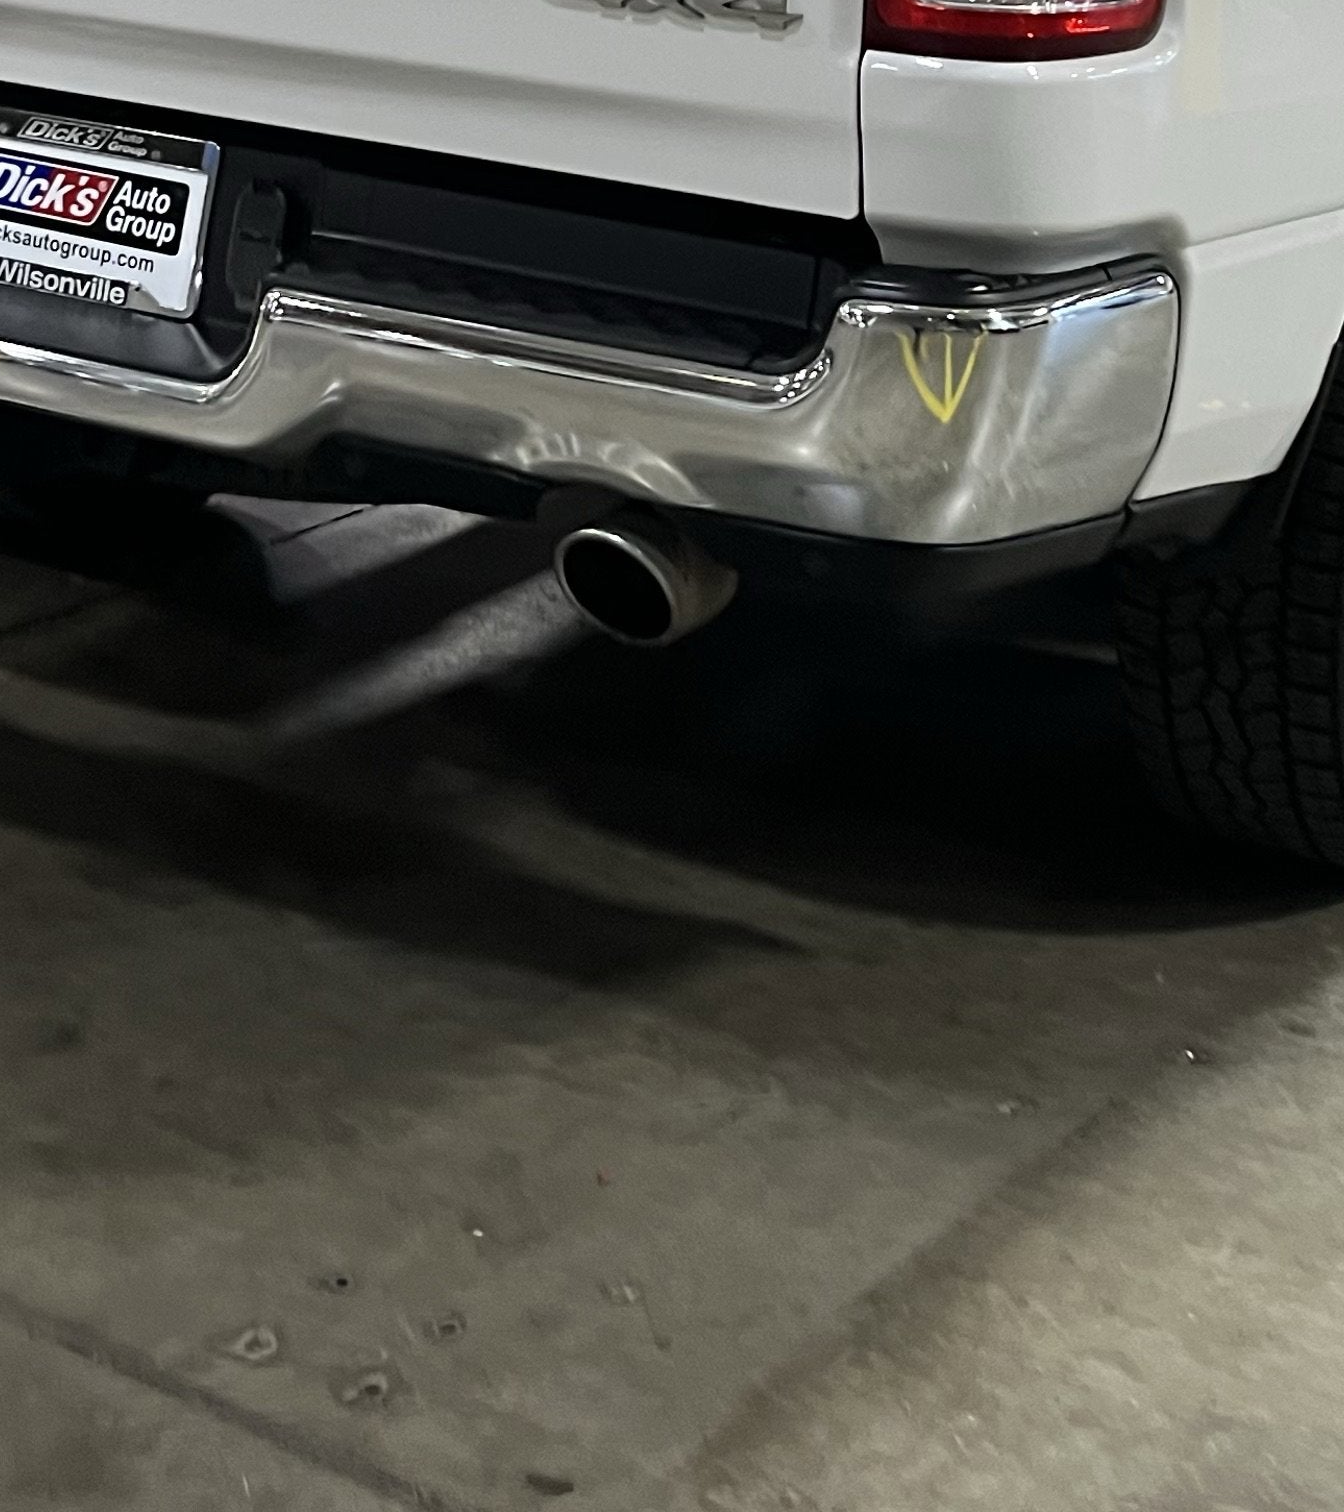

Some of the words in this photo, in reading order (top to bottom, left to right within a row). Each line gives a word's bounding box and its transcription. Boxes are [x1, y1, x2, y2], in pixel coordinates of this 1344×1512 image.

[23, 119, 105, 148] Dick's
[112, 131, 145, 145] Auto
[107, 141, 148, 158] Group
[113, 180, 171, 215] Auto
[105, 206, 176, 247] Group
